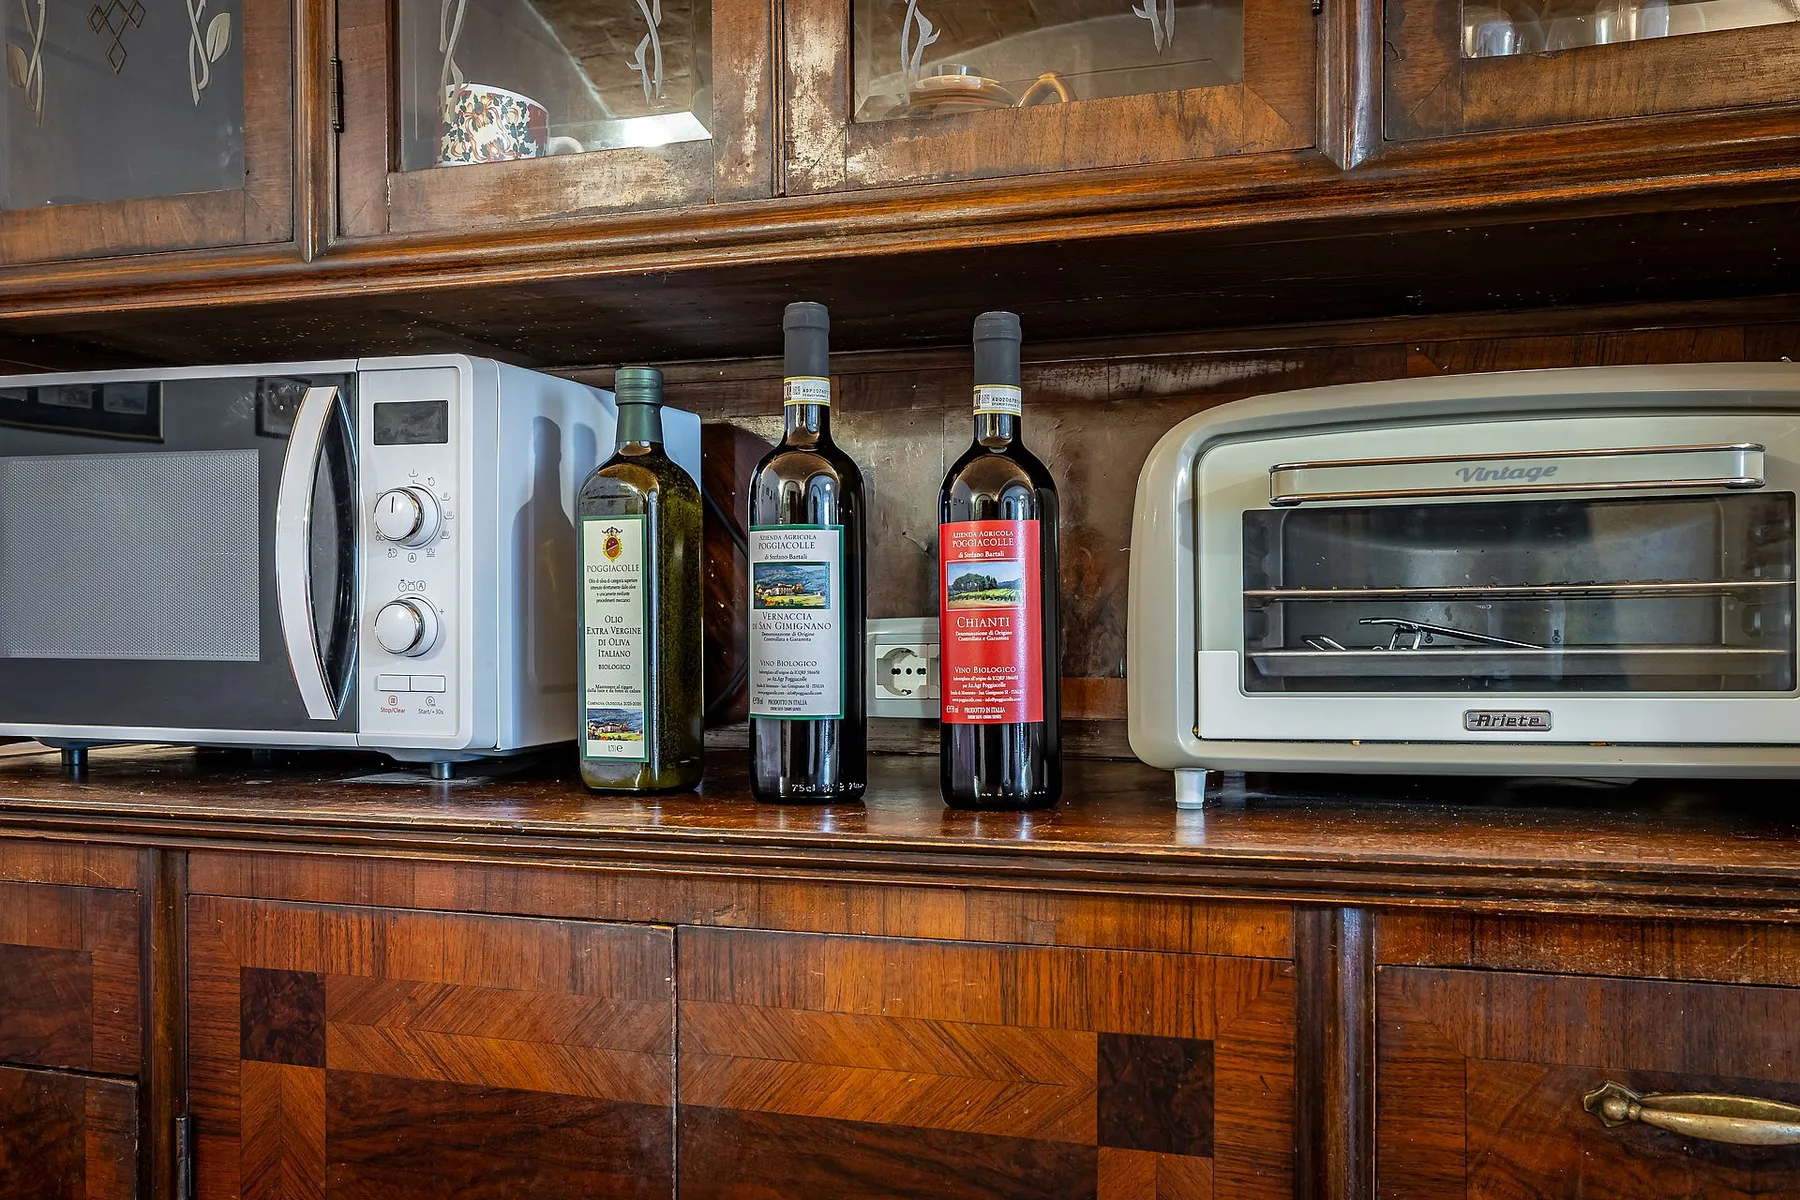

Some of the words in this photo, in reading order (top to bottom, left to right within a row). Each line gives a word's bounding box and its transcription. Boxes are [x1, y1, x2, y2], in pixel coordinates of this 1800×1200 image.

[1455, 466, 1558, 482] Vintage
[759, 542, 815, 550] POGGIACOLLE
[952, 538, 1014, 548] POGGIACOLLE
[586, 564, 640, 573] POGGIACOLLE
[604, 615, 623, 623] OLIO
[762, 612, 812, 621] VERNACCIA
[758, 622, 772, 630] SAN
[775, 622, 832, 630] GIMIGNANO
[956, 616, 1010, 628] CHIANTI
[586, 626, 608, 635] EXTRA
[611, 626, 641, 635] VERGINE
[608, 638, 630, 646] OLIVA
[598, 649, 631, 658] ITALIANO
[954, 666, 971, 674] VINO
[973, 666, 1017, 674] BIOLOGICO
[1470, 714, 1546, 727] Ariete
[792, 784, 816, 792] 75cl
